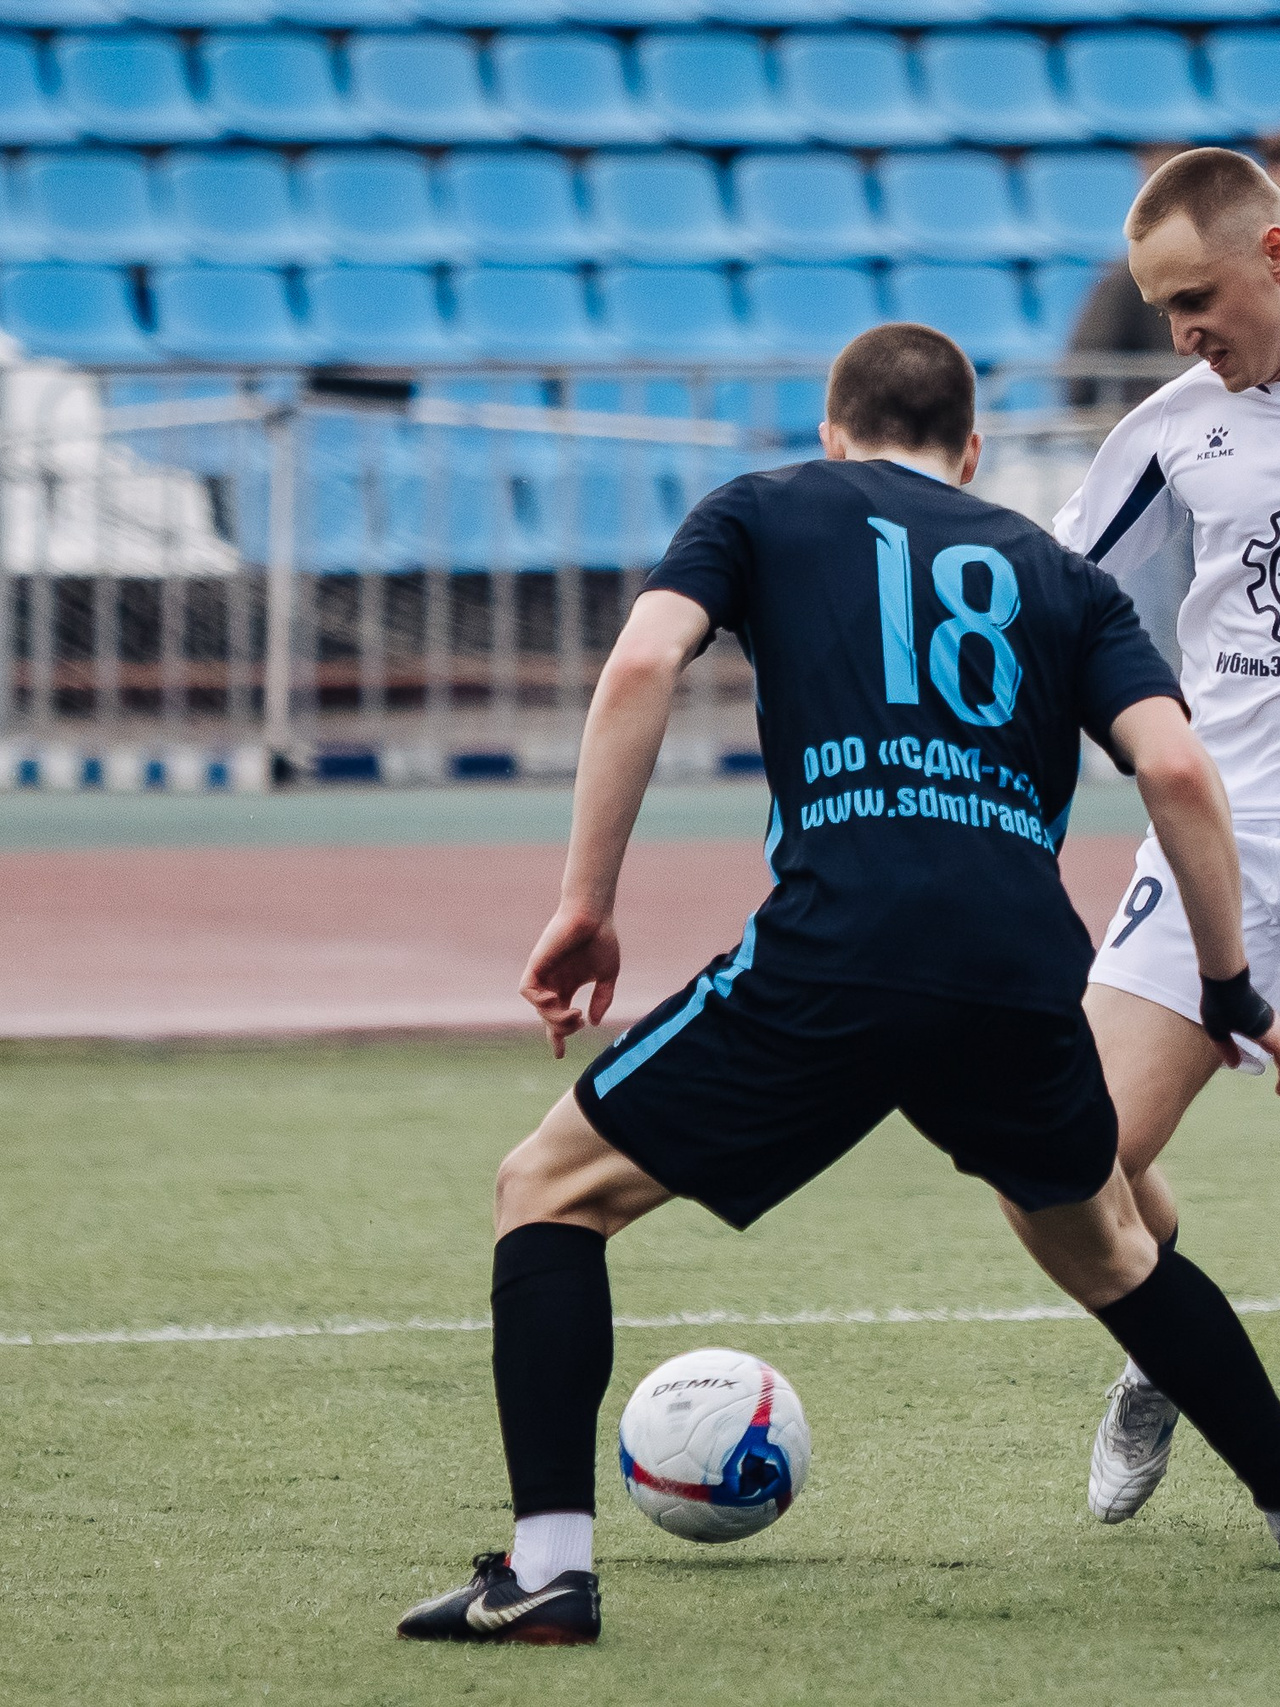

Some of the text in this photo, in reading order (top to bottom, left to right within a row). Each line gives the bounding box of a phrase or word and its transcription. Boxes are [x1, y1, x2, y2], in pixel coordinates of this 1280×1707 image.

[1197, 448, 1235, 460] KELME
[867, 516, 1023, 727] 18
[804, 736, 866, 784] ООО
[1110, 875, 1163, 949] 9
[650, 1378, 742, 1399] DEMIX
